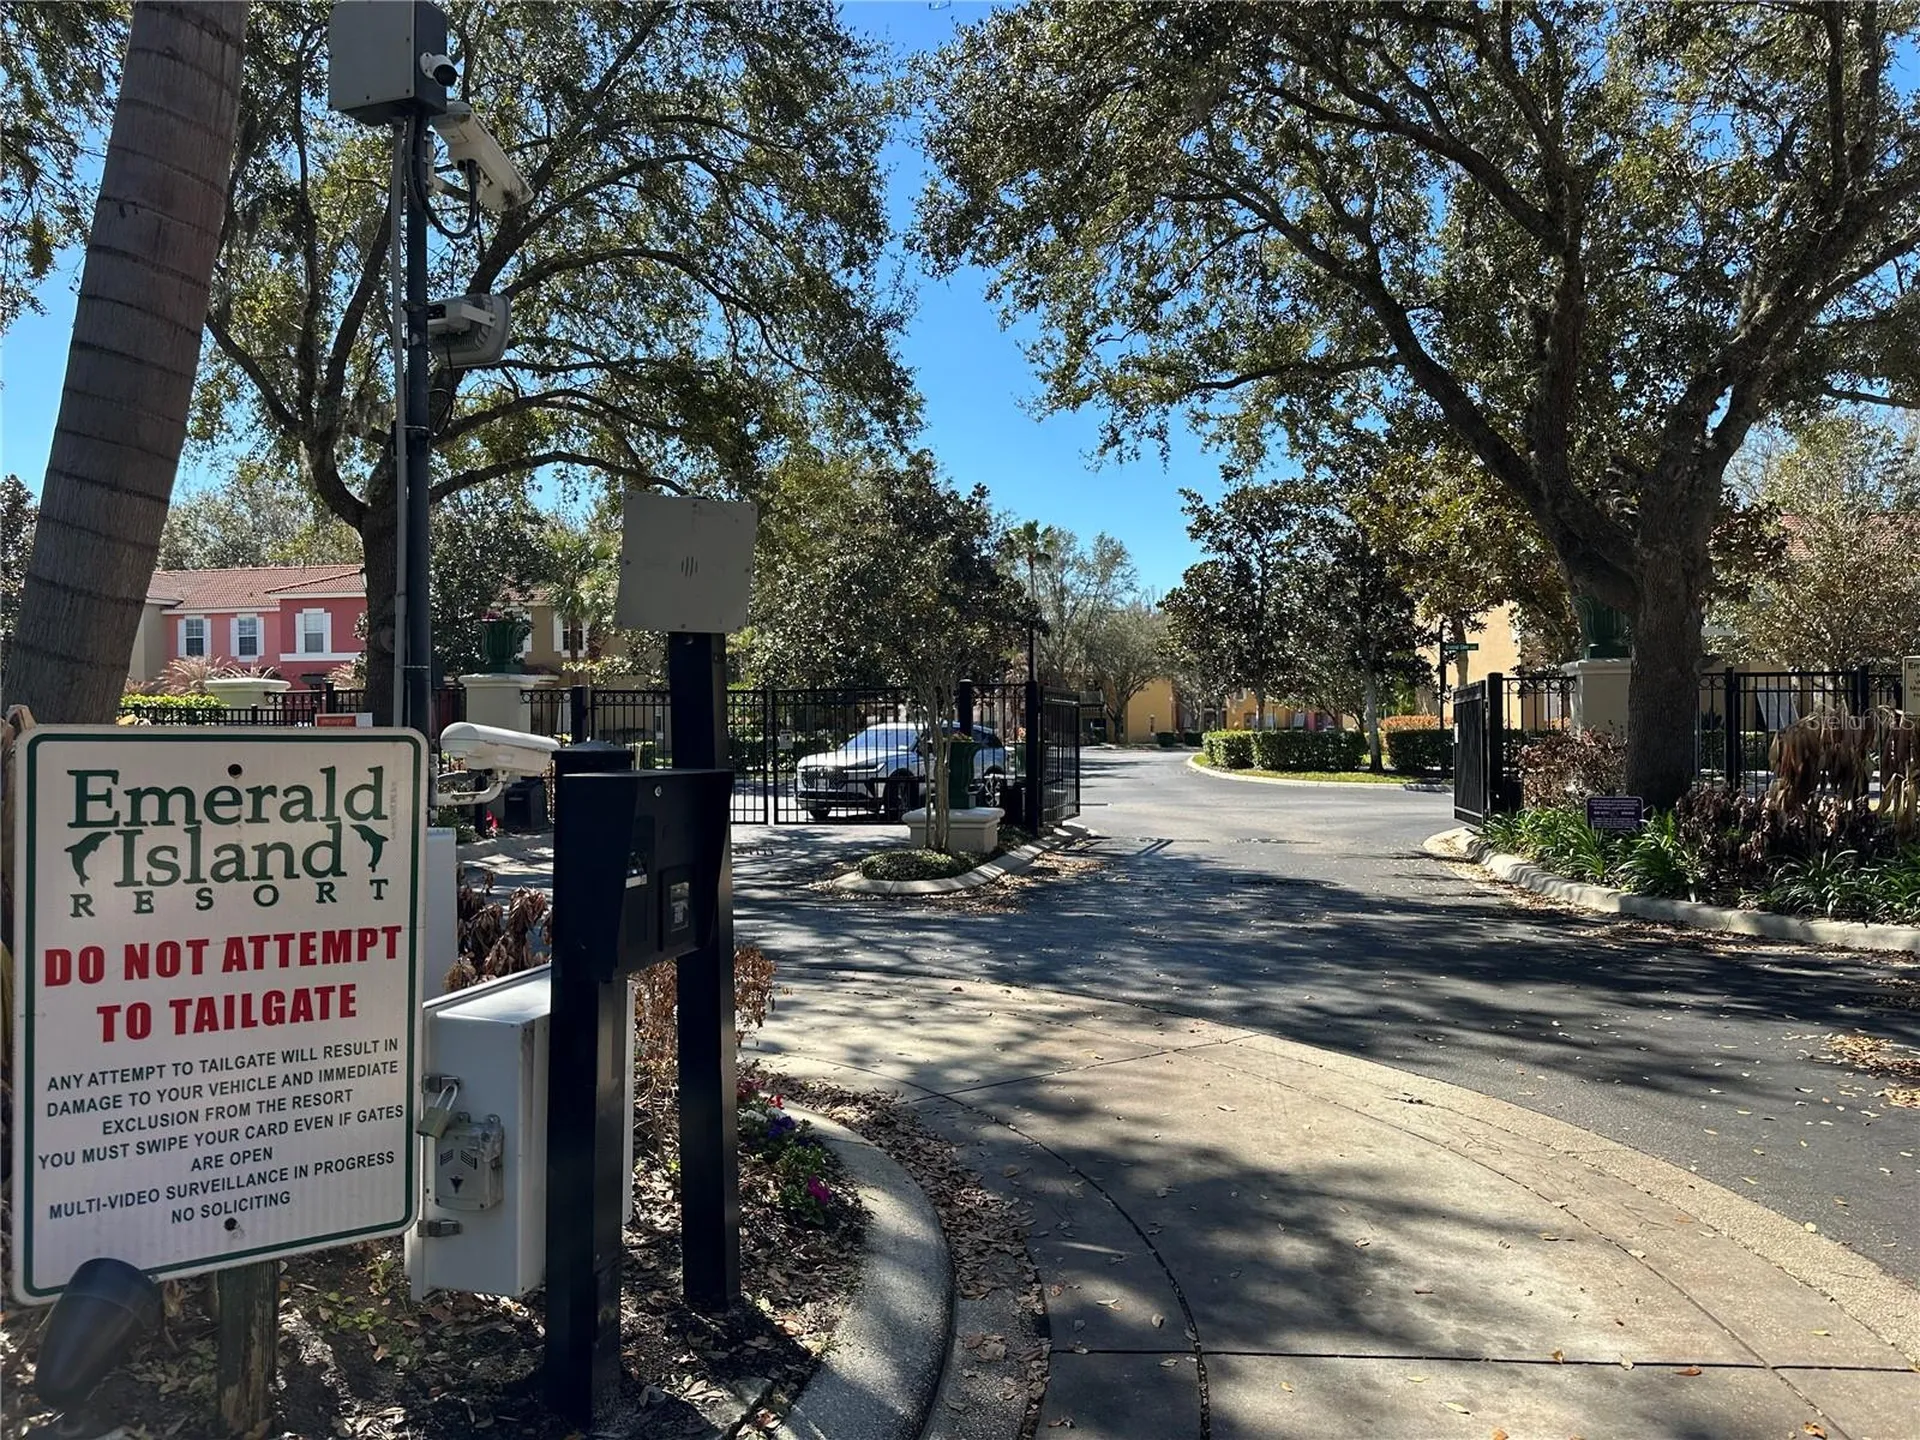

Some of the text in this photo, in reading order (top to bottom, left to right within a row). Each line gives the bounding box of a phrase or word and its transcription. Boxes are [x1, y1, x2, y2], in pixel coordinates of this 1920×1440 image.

[67, 766, 388, 828] Emerald
[114, 822, 347, 887] Island
[70, 879, 388, 918] RESORT
[45, 926, 402, 987] DO NOT ATTEMPT
[97, 984, 356, 1042] TO TAILGATE
[47, 1038, 398, 1092] ANY ATTEMPT TO TAILGATE WILL RESULT IN
[47, 1060, 398, 1117] DAMAGE TO YOUR VEHICLE AND IMMEDIATE
[39, 1105, 403, 1170] YOU MUST SWIPE YOUR CARD EVEN IF GATES
[103, 1089, 353, 1136] EXCLUSION FROM THE RESORT
[50, 1151, 394, 1219] MULTI-VIDEO SURVEILLANCE IN PROGRESS
[191, 1147, 273, 1172] ARE OPEN
[172, 1191, 291, 1224] NO SOLICITING
